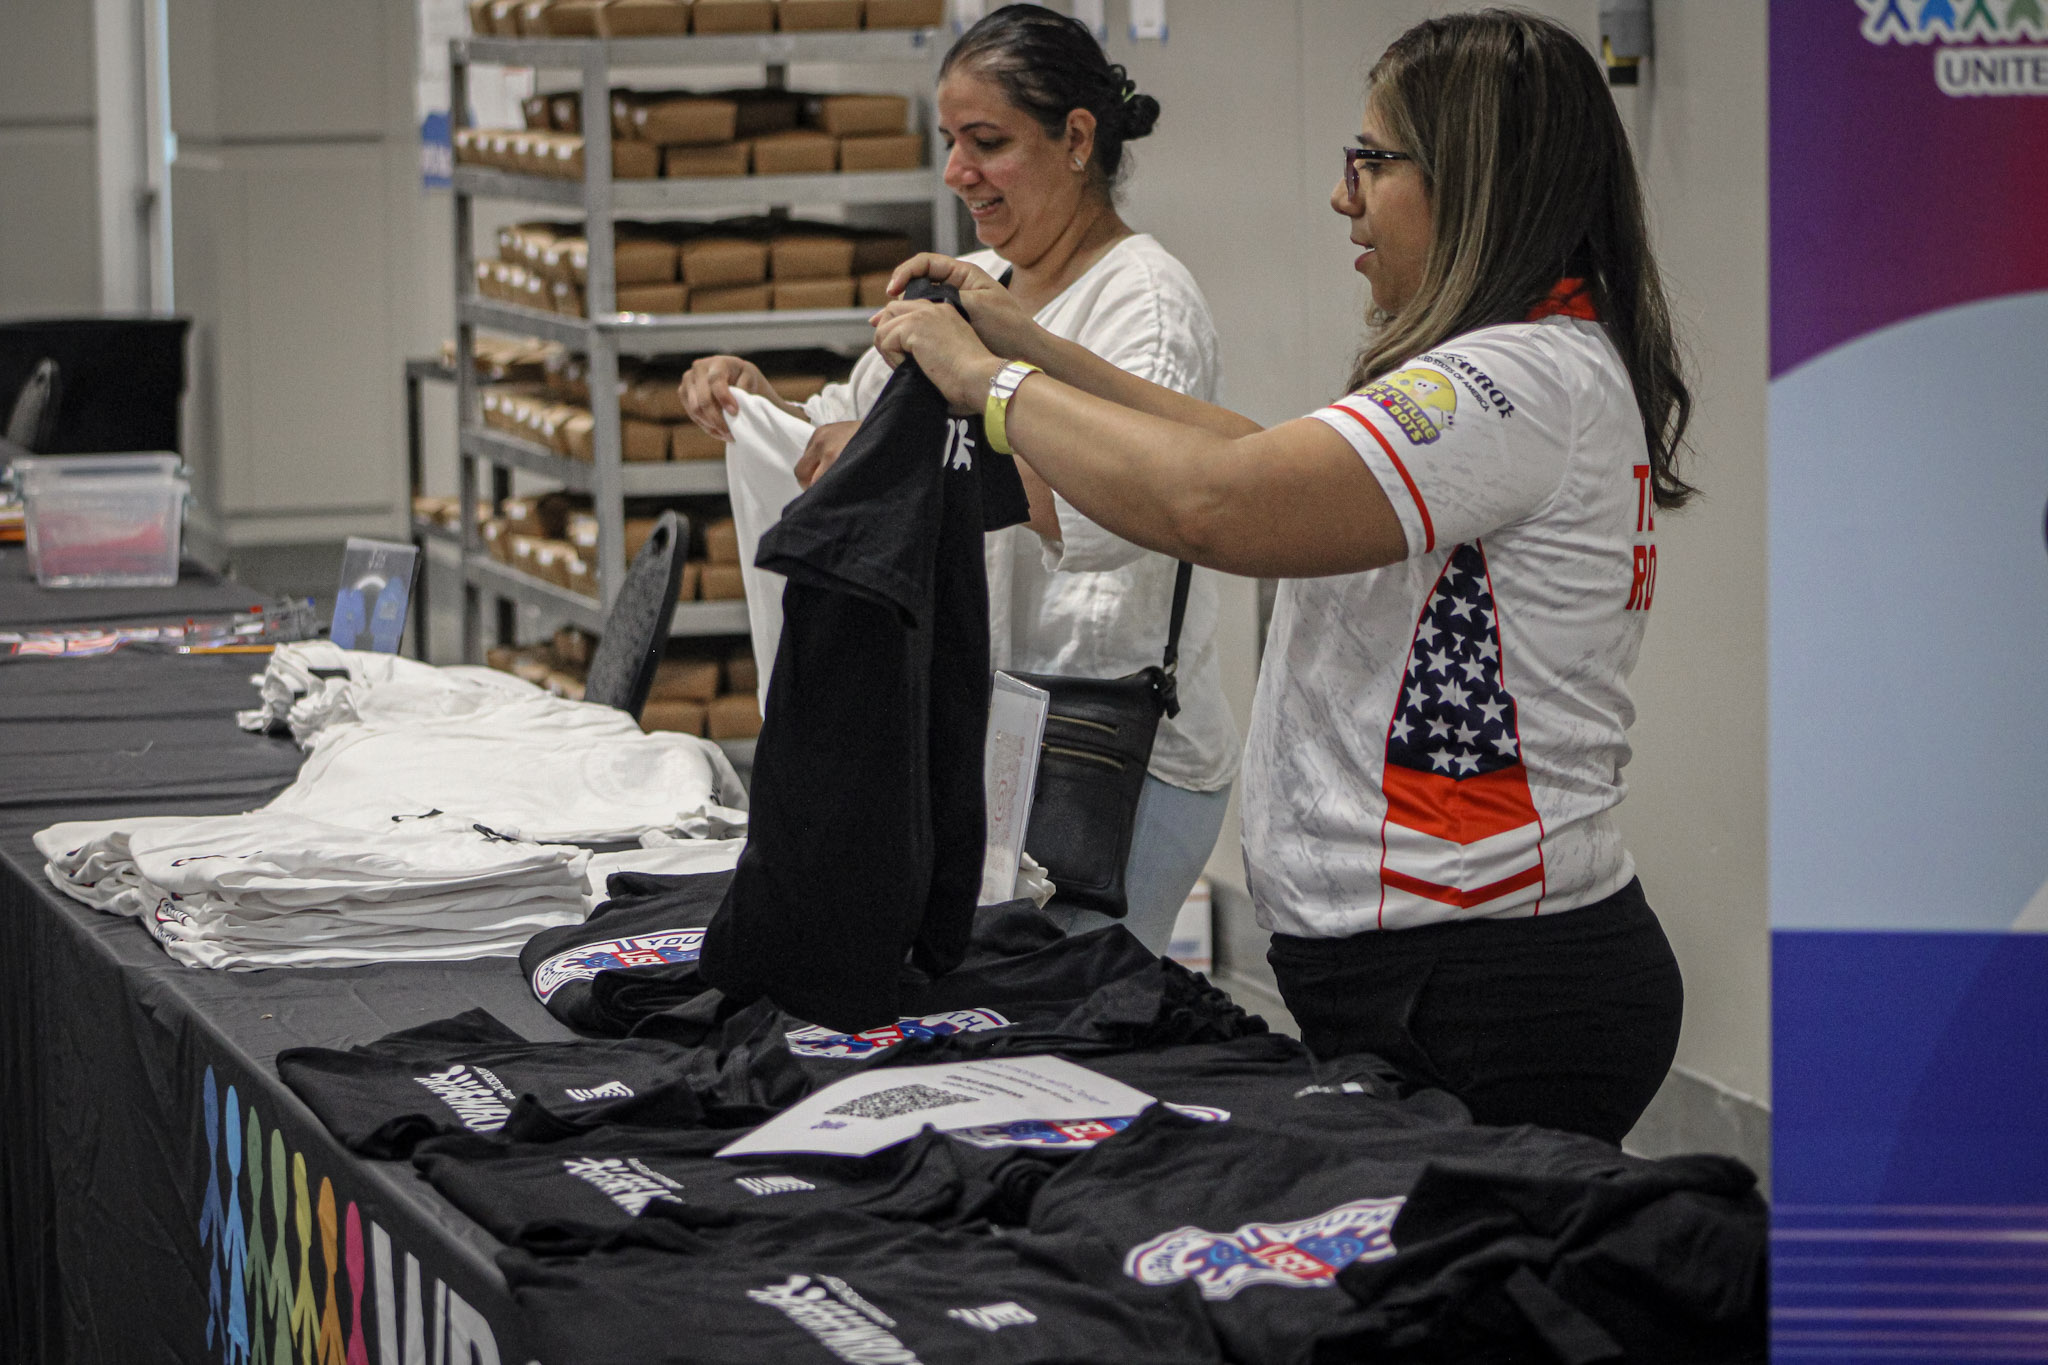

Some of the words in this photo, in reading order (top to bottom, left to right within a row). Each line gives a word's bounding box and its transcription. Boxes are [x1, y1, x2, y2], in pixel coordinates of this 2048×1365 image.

[1433, 357, 1456, 374] STATES
[1453, 372, 1465, 381] OF
[1462, 381, 1490, 412] AMERICA
[1386, 388, 1437, 440] FUTURE
